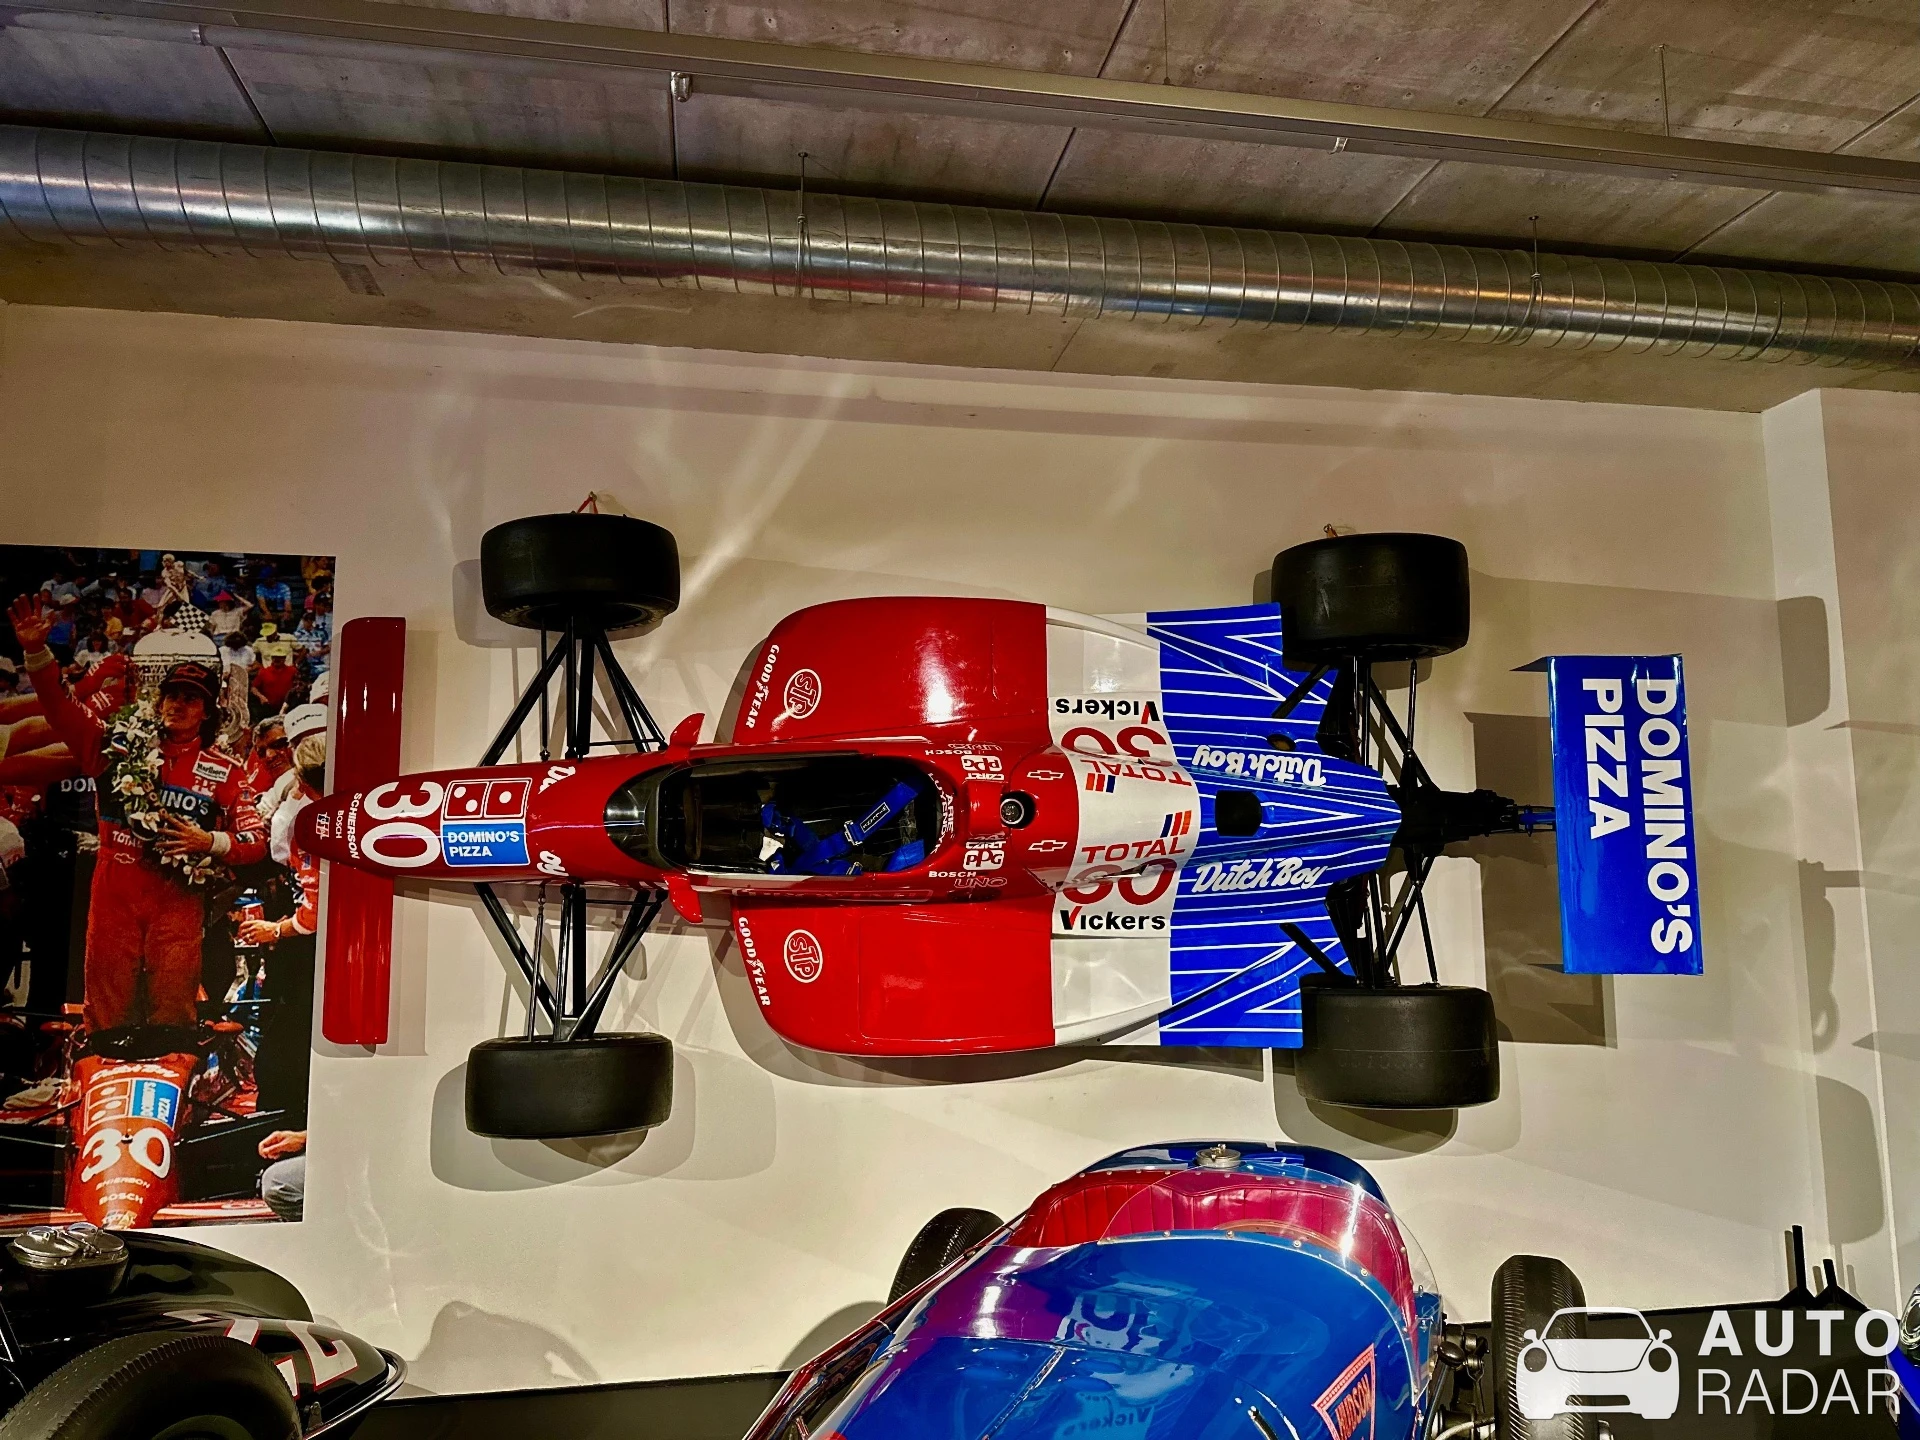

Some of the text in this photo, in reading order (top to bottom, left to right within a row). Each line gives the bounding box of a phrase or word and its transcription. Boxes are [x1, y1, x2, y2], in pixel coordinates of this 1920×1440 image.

[746, 645, 780, 728] GOODYEAR
[789, 673, 817, 714] STP
[1056, 699, 1160, 724] Vickers
[197, 762, 227, 776] Marlboro
[1080, 759, 1192, 786] TOTAL
[1191, 745, 1327, 787] Dutch Boy
[1582, 678, 1631, 840] PIZZA
[161, 789, 210, 816] INO'S
[945, 794, 954, 833] ARIE
[1636, 678, 1693, 954] DOMINO'S
[336, 810, 345, 839] BOSCH
[347, 792, 363, 859] SCHIERSON
[360, 781, 444, 868] 30
[447, 830, 520, 843] DOMINO'S
[449, 846, 492, 857] PIZZA
[1082, 837, 1186, 863] TOTAL
[953, 877, 1007, 888] UNO
[1191, 857, 1328, 893] Dutch Boy
[1060, 906, 1166, 930] Vickers
[738, 917, 771, 1006] GOODYEAR
[789, 937, 820, 978] STP
[81, 1127, 171, 1182] 30
